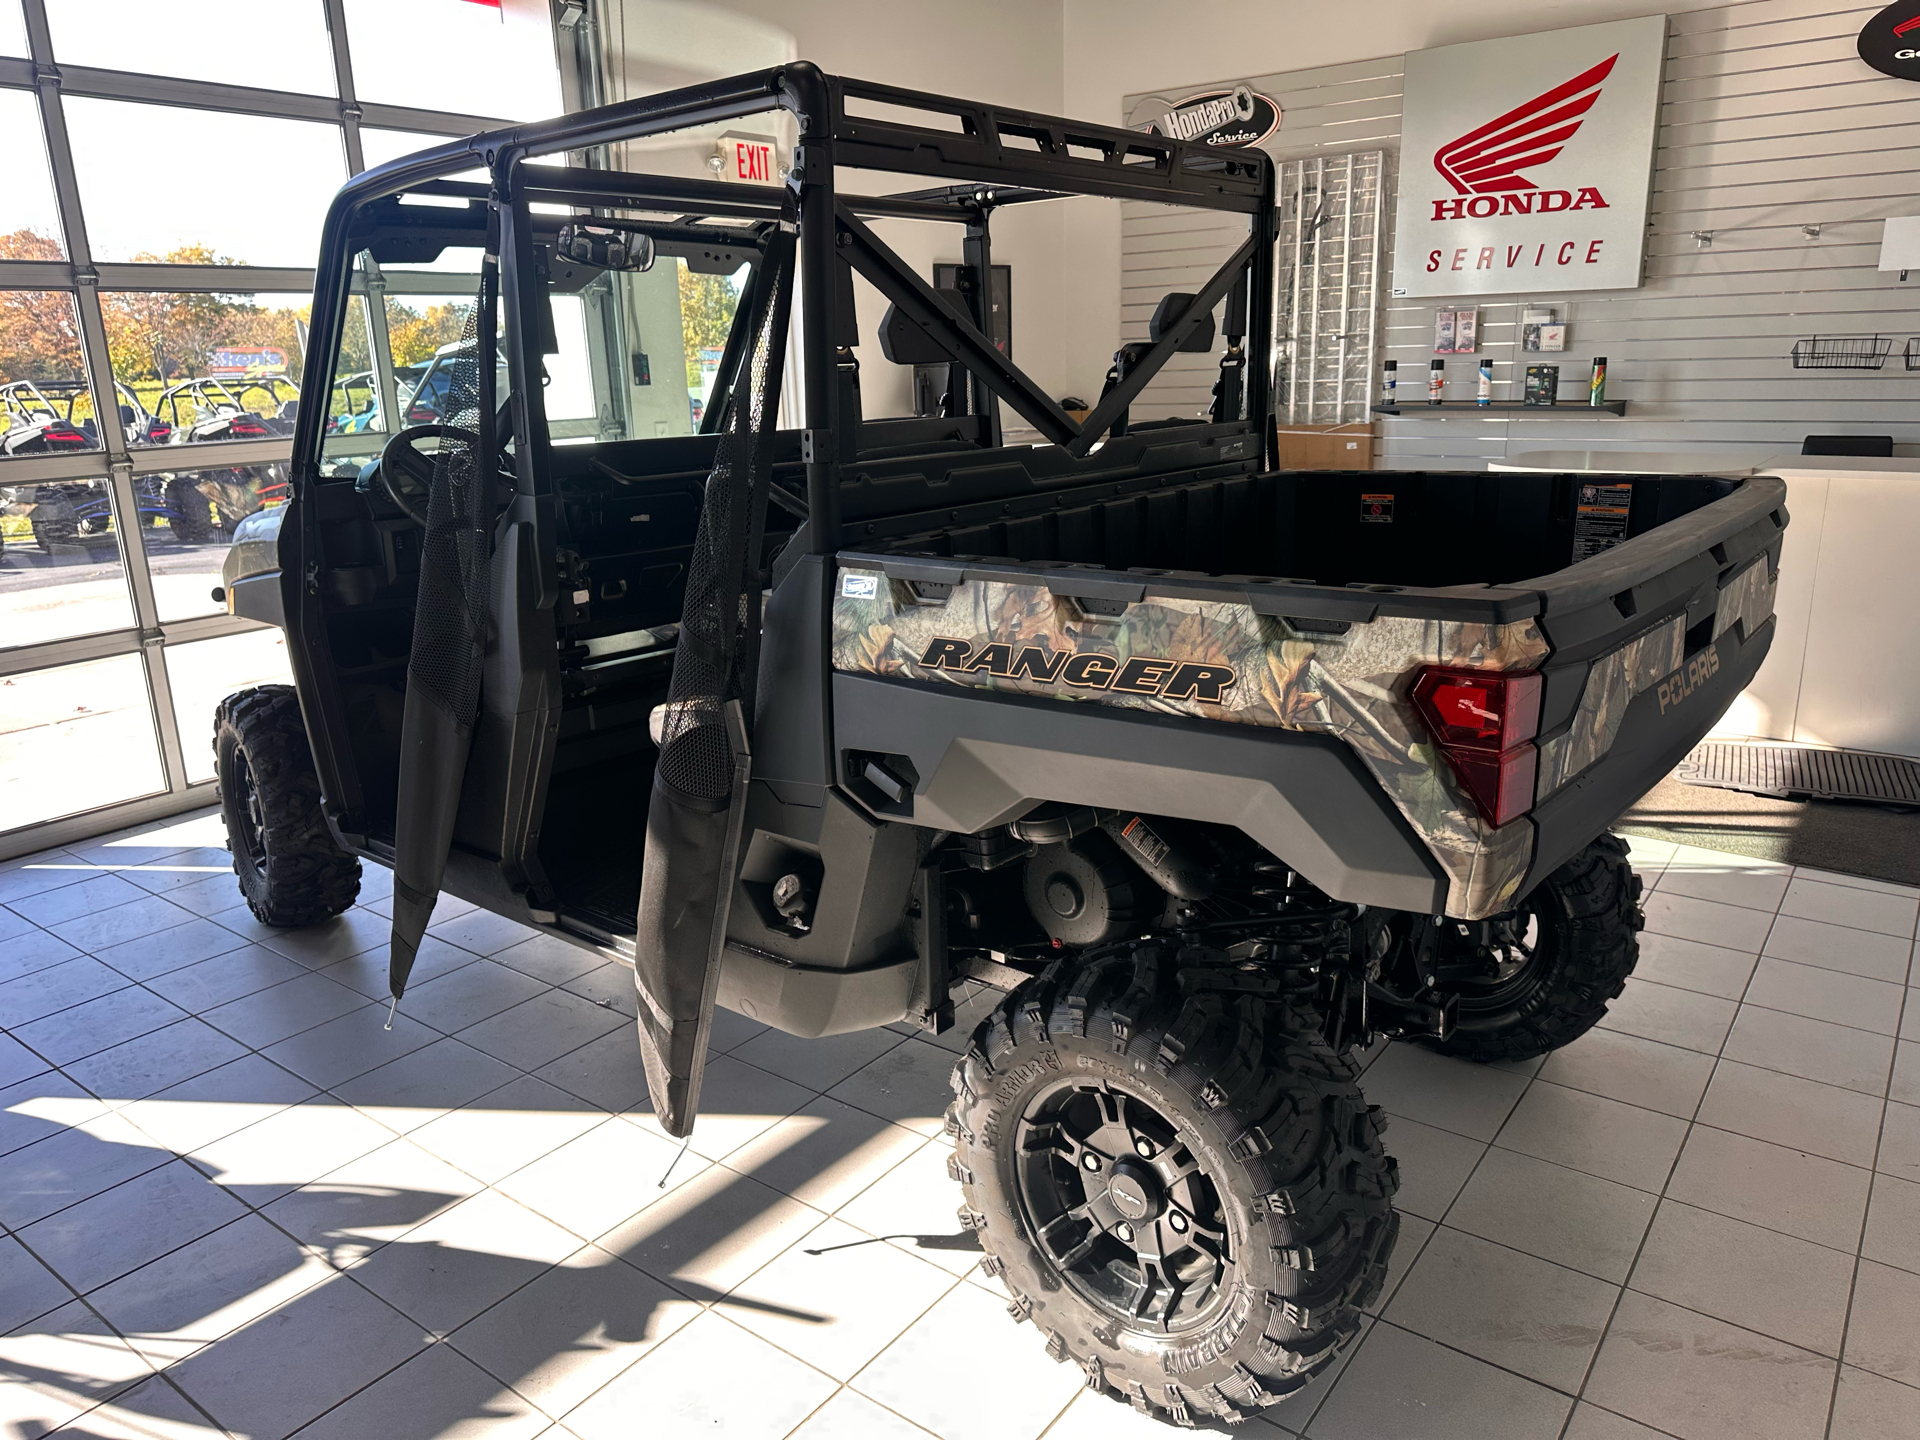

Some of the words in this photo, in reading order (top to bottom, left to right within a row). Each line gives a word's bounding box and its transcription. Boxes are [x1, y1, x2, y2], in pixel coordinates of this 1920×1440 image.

[1164, 100, 1235, 140] HondaPro
[1206, 129, 1258, 144] Service
[736, 142, 769, 181] EXIT
[1430, 187, 1610, 221] HONDA
[1426, 240, 1603, 272] SERVICE
[917, 636, 1236, 703] RANGER
[1657, 643, 1719, 716] POLARIS
